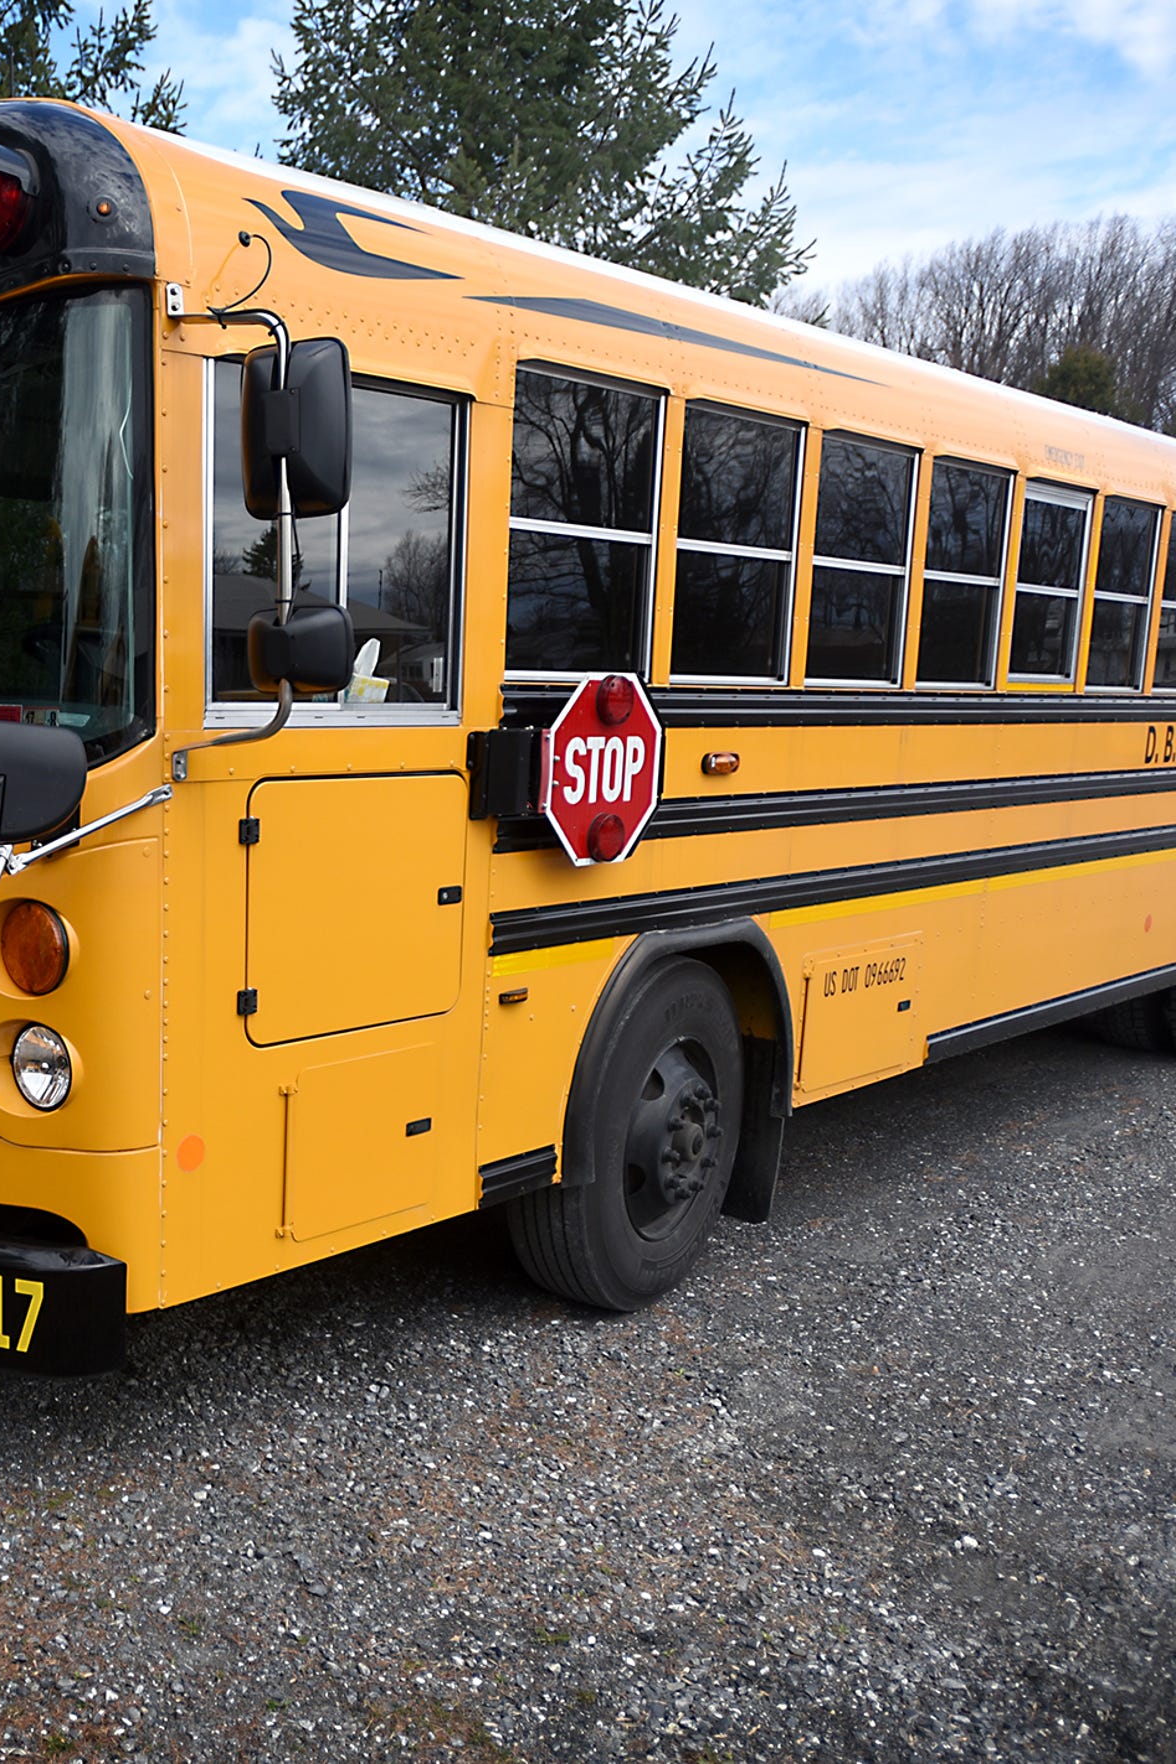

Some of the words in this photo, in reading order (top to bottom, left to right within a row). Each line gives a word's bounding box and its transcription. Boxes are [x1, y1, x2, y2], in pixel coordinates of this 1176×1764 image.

[562, 735, 646, 805] STOP
[823, 971, 837, 997] US
[841, 966, 860, 993] DOT
[864, 957, 906, 988] 0966692
